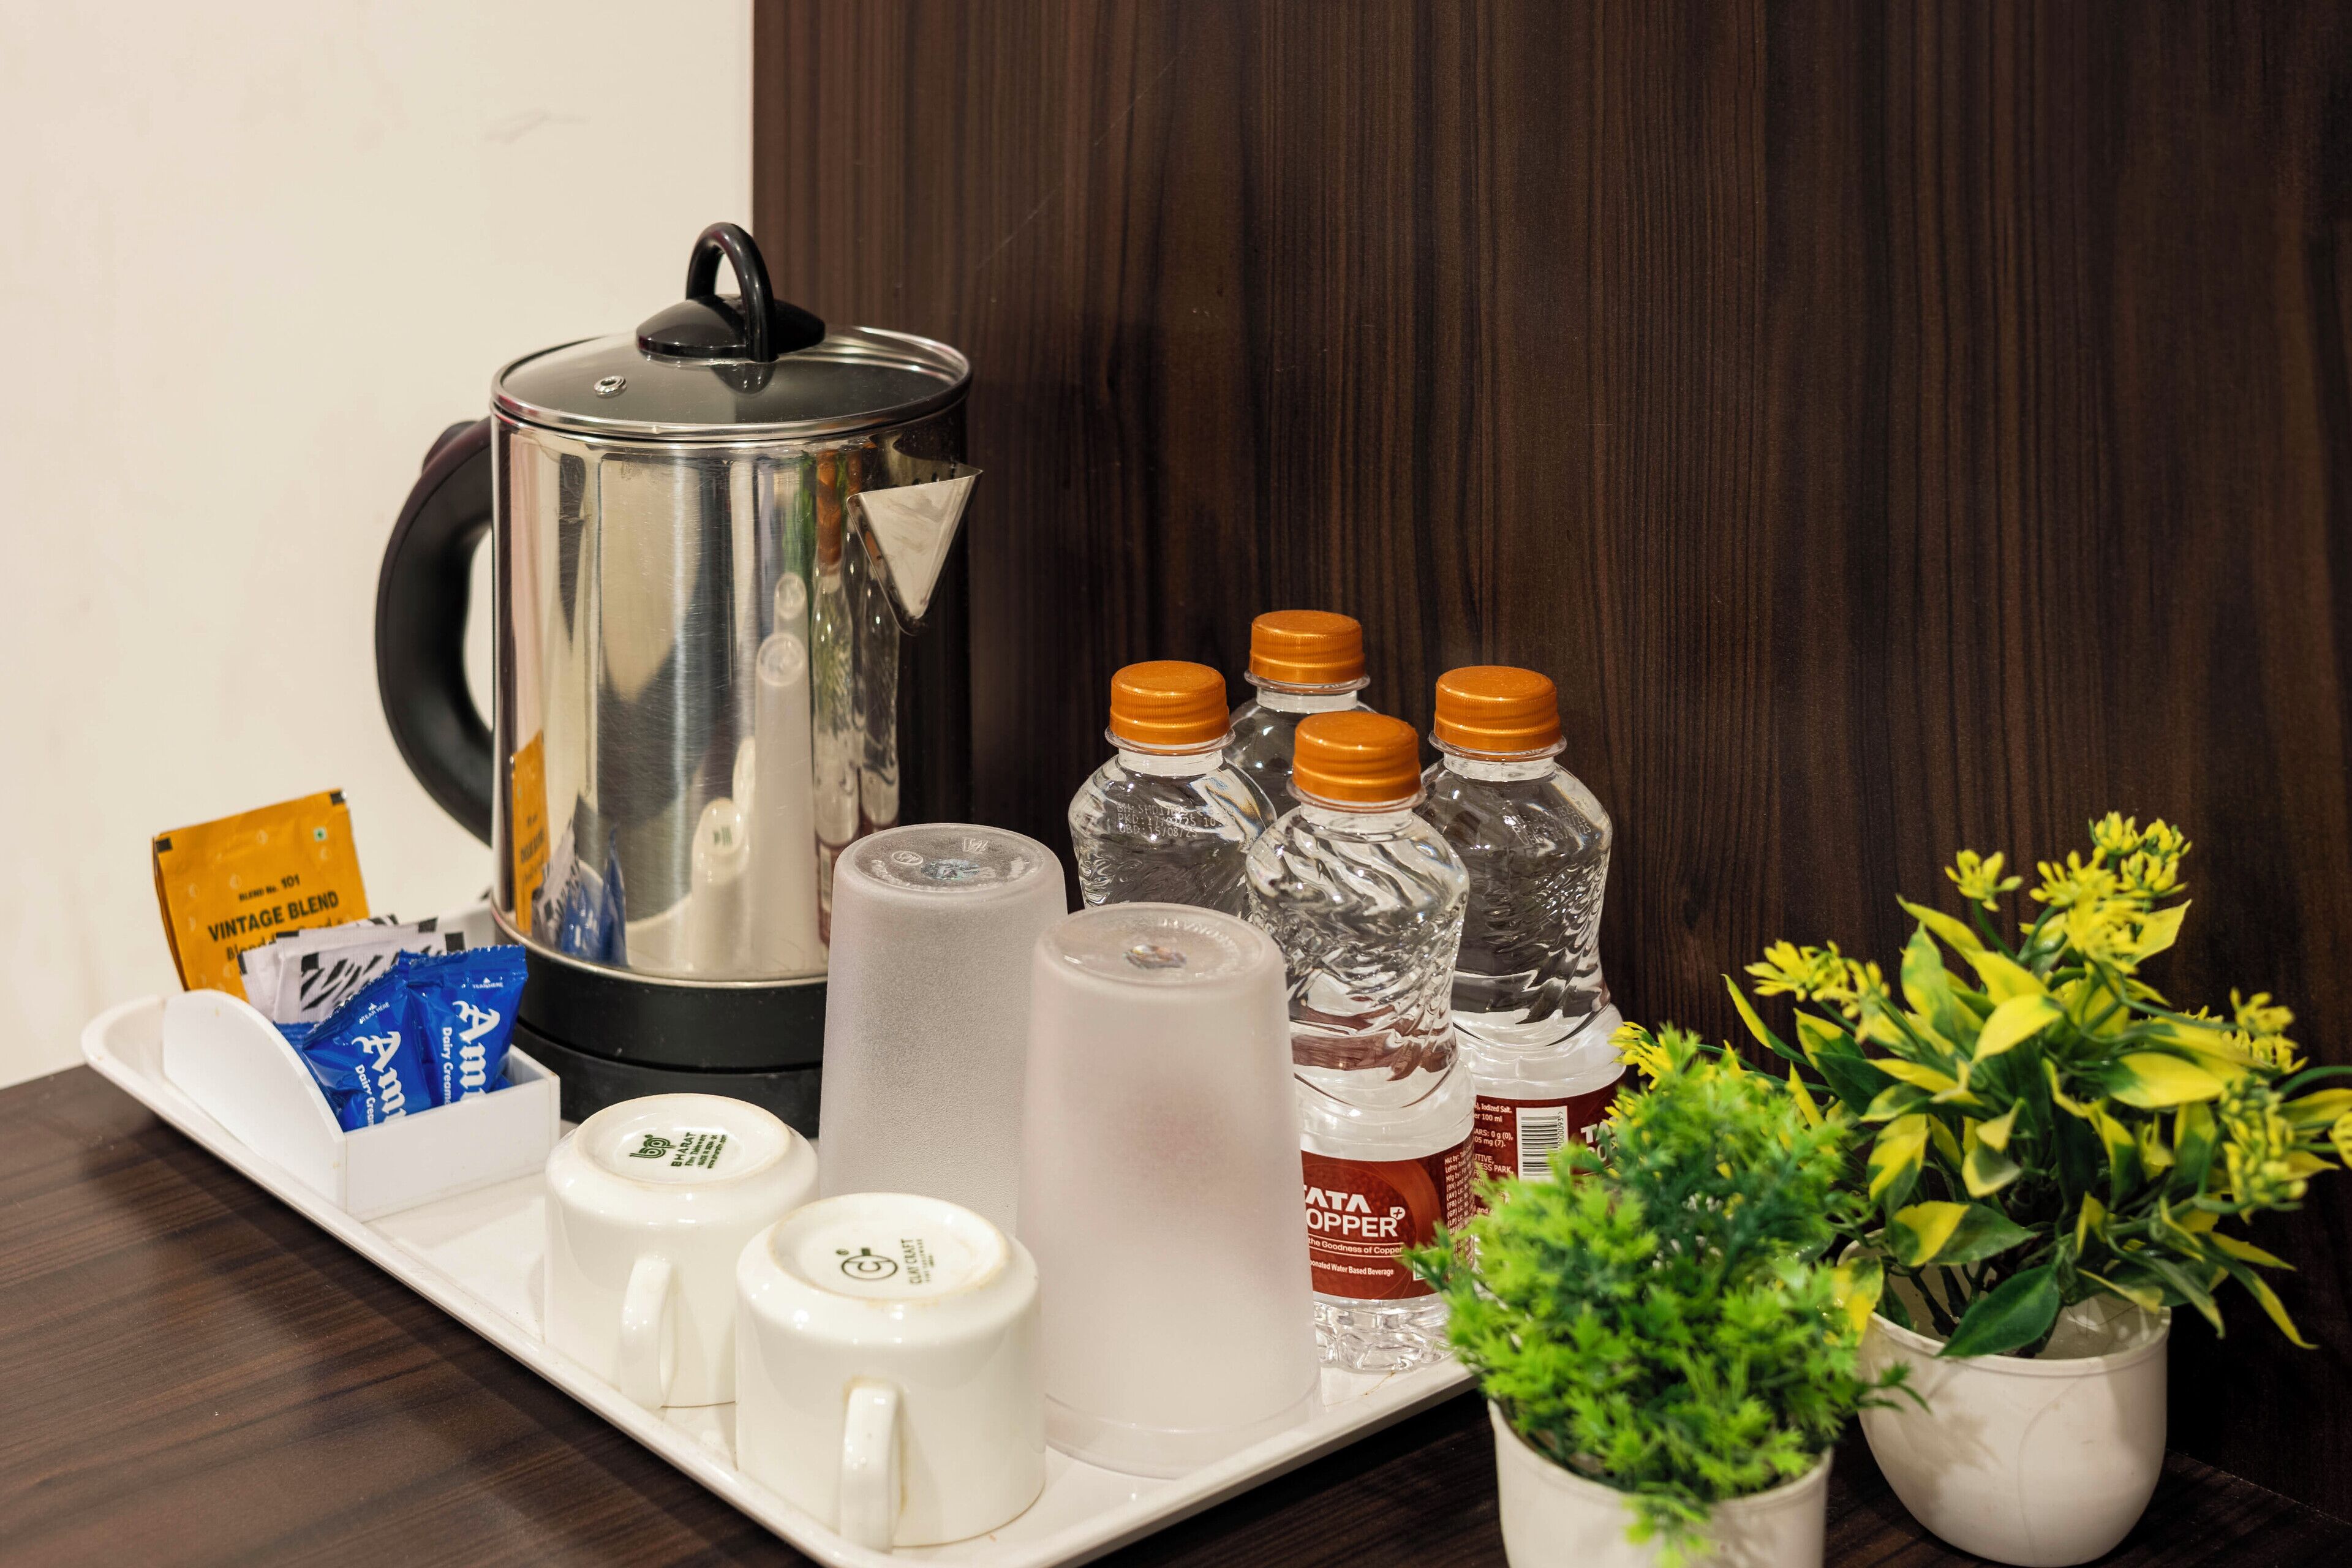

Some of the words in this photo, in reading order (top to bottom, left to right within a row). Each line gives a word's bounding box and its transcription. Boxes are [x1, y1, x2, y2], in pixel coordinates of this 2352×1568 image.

[239, 886, 265, 902] BLEND
[281, 874, 300, 889] 101
[208, 906, 284, 941] VINTAGE
[288, 891, 339, 919] BLEND
[376, 1002, 390, 1012] HERE
[441, 1027, 453, 1059] Dairy
[352, 1031, 407, 1122] Am
[355, 1064, 372, 1095] Dairy
[1481, 1103, 1499, 1112] Iodized
[1494, 1139, 1506, 1148] (7).
[1502, 1132, 1513, 1140] (0),
[671, 1132, 696, 1167] BHARAT
[1494, 1164, 1514, 1175] PARK,
[1303, 1185, 1371, 1214] ATA
[1447, 1190, 1457, 1201] (AV)
[1305, 1208, 1398, 1238] OPPER
[901, 1238, 918, 1264] CRAFT
[1308, 1237, 1320, 1246] the
[1322, 1241, 1362, 1253] Goodness
[1374, 1246, 1403, 1255] Copper
[907, 1266, 922, 1284] CLAY
[1332, 1263, 1348, 1273] Water
[1349, 1265, 1366, 1275] Based
[1368, 1267, 1394, 1277] Beverage
